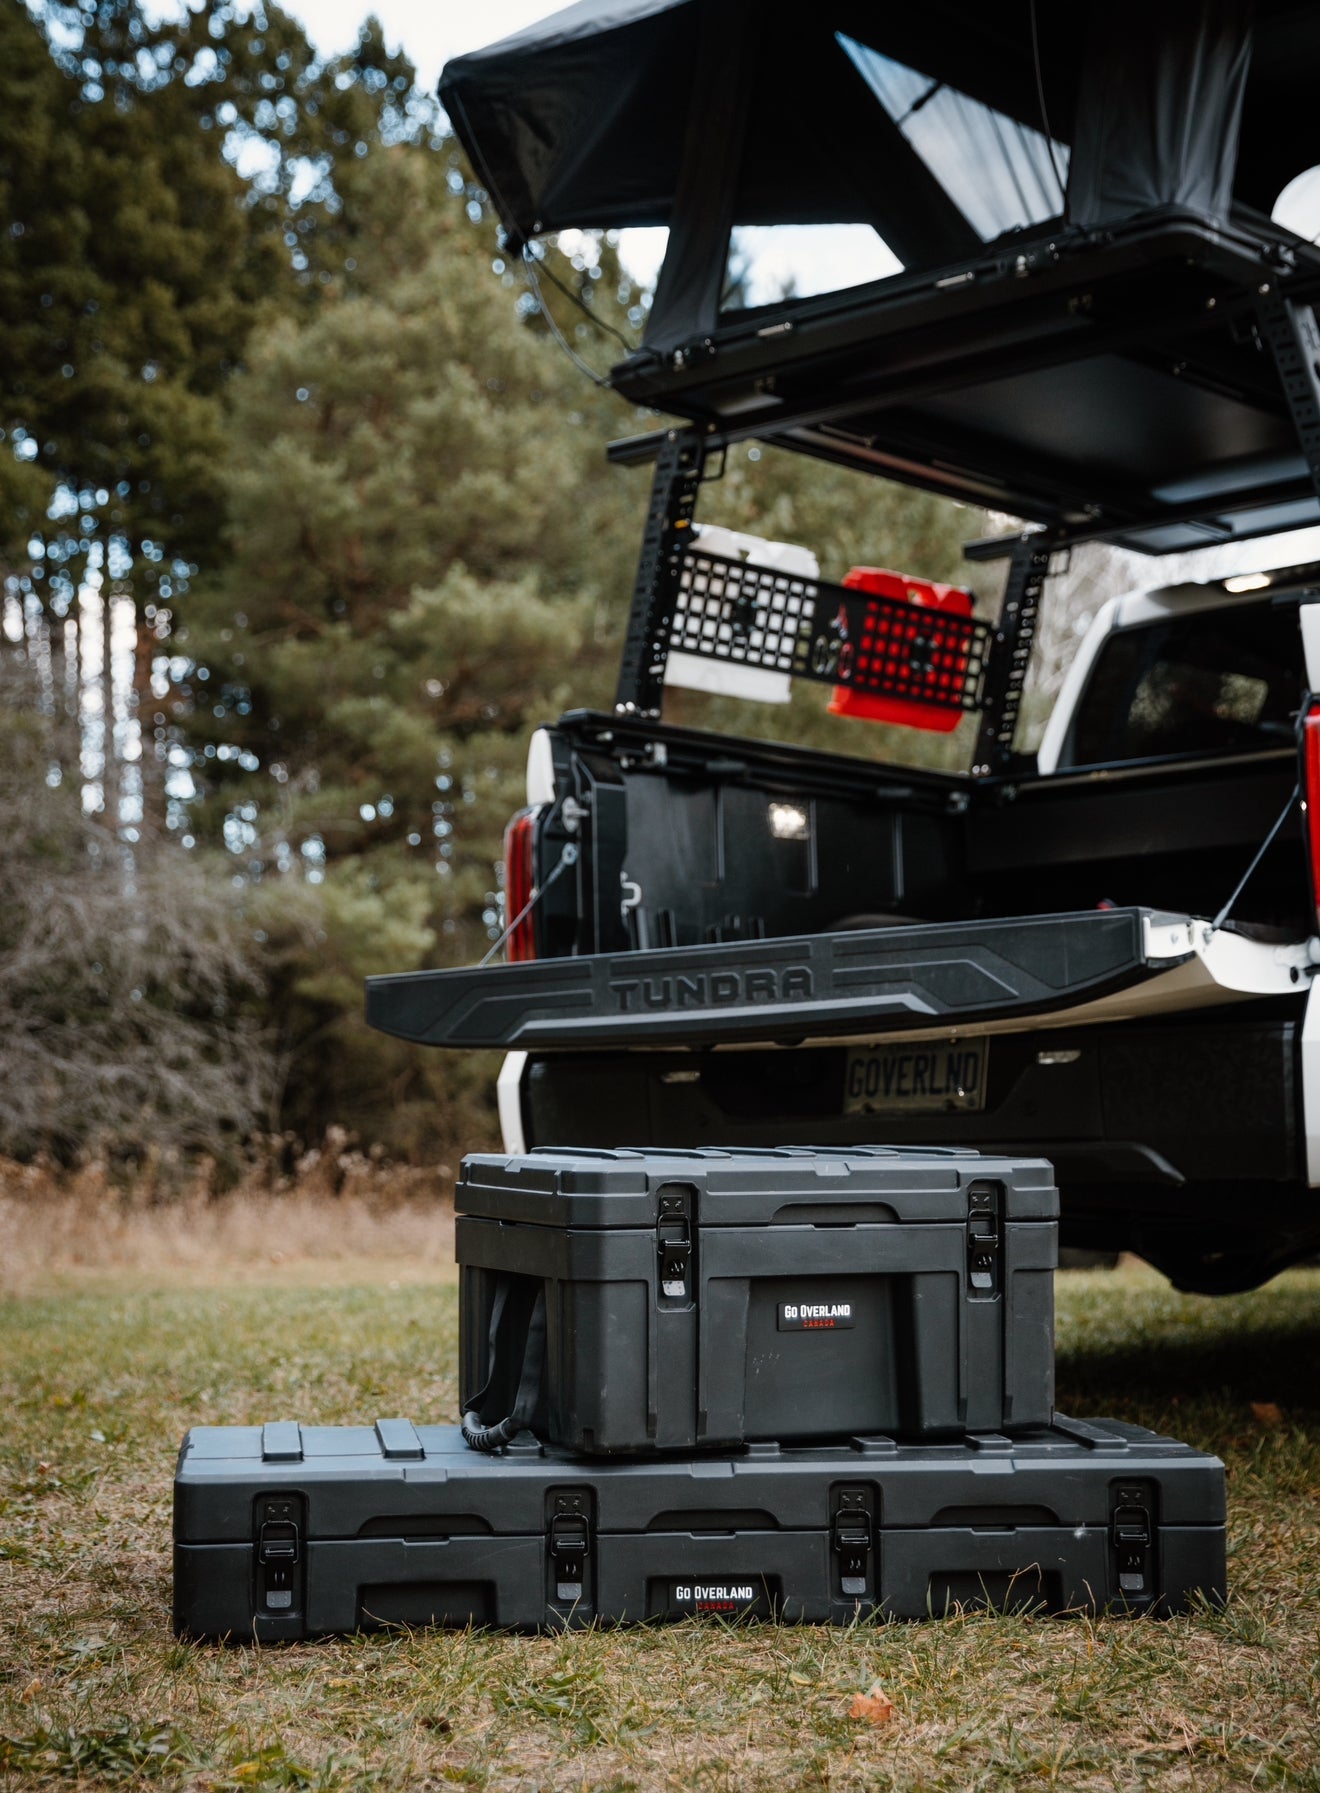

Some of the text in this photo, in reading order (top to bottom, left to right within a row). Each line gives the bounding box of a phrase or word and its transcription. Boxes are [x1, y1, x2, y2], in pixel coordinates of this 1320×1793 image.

[608, 965, 814, 1011] TUNDRA
[848, 1052, 979, 1098] GOVERLND
[803, 1319, 835, 1327] CANADA
